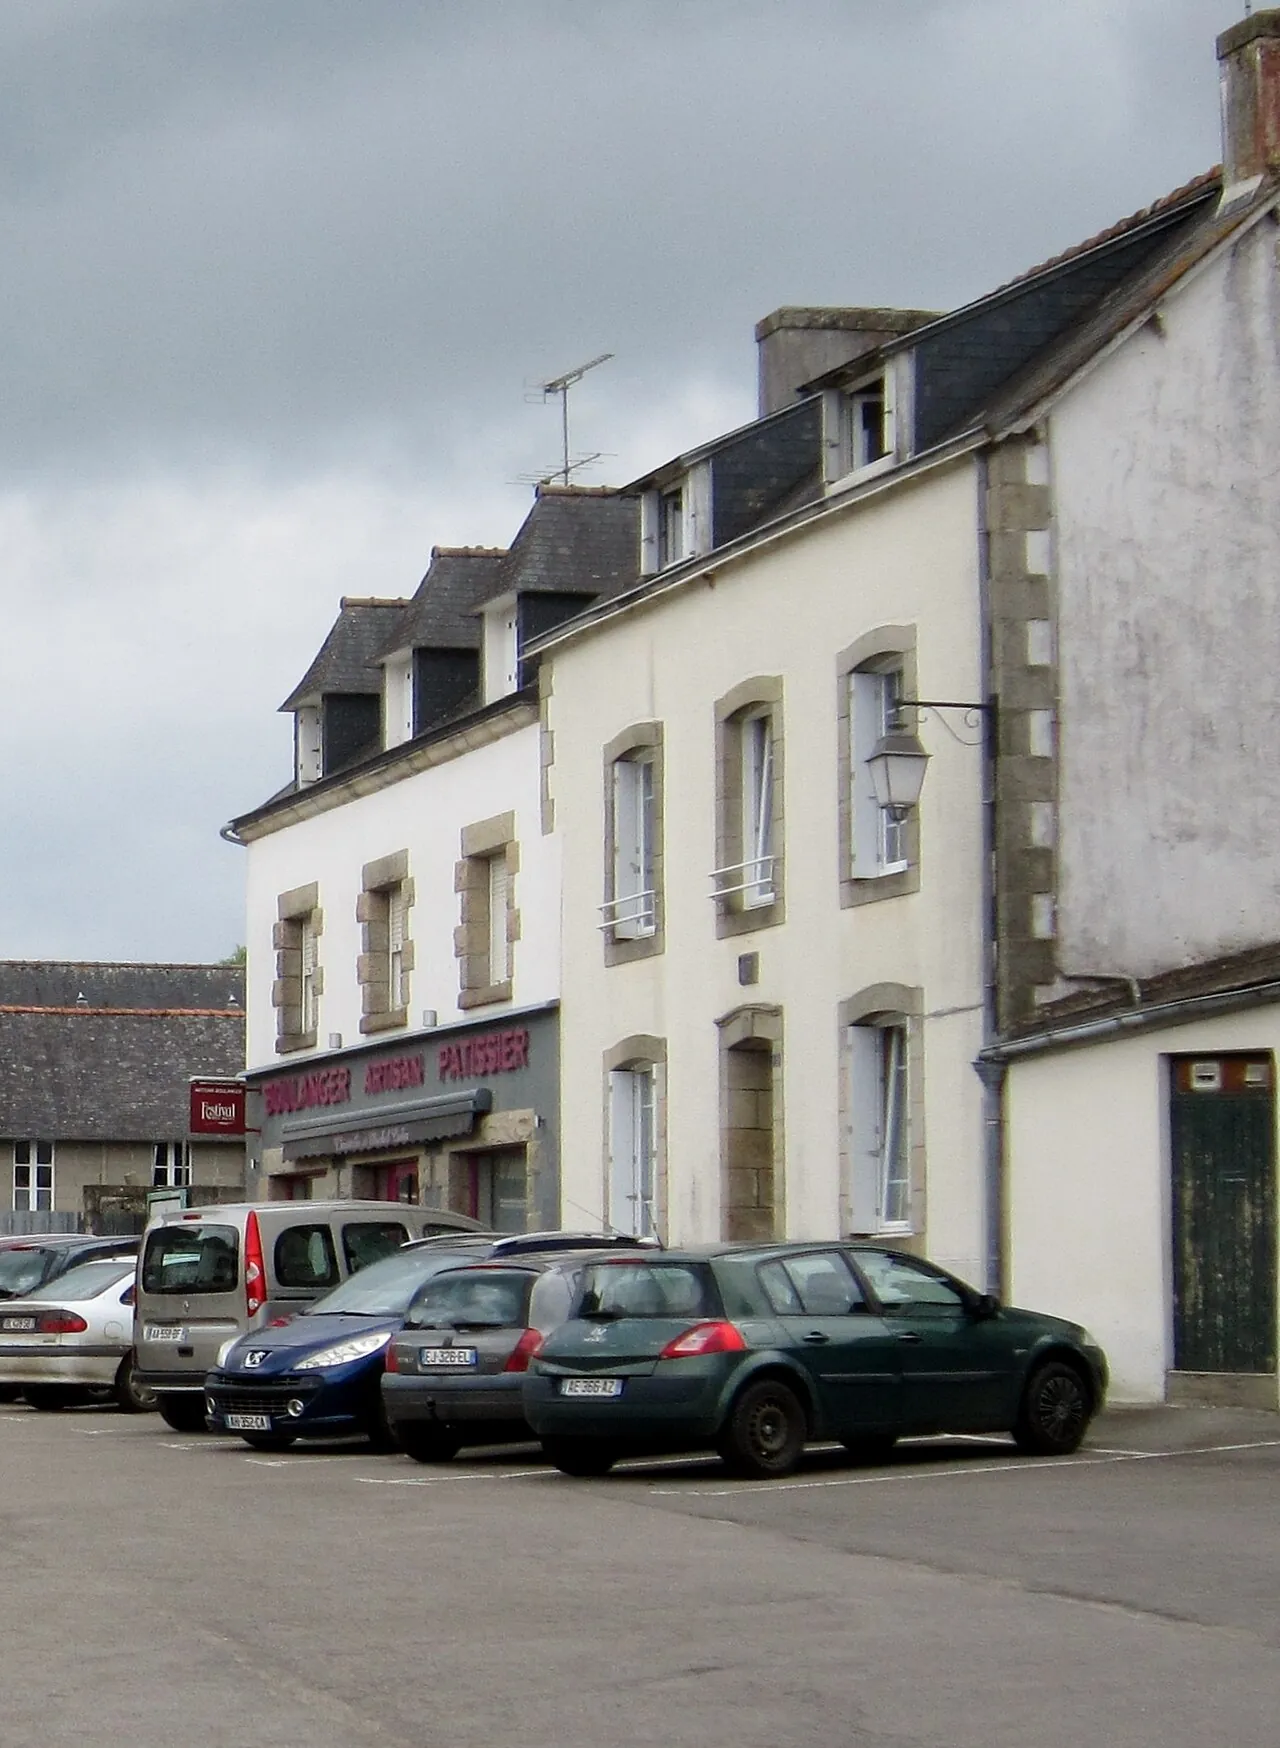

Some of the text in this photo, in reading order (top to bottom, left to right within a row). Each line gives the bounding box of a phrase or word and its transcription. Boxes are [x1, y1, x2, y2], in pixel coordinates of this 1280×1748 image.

[263, 1067, 351, 1115] BOULANGER
[364, 1054, 425, 1095] ARTISAN
[201, 1101, 236, 1120] Festival
